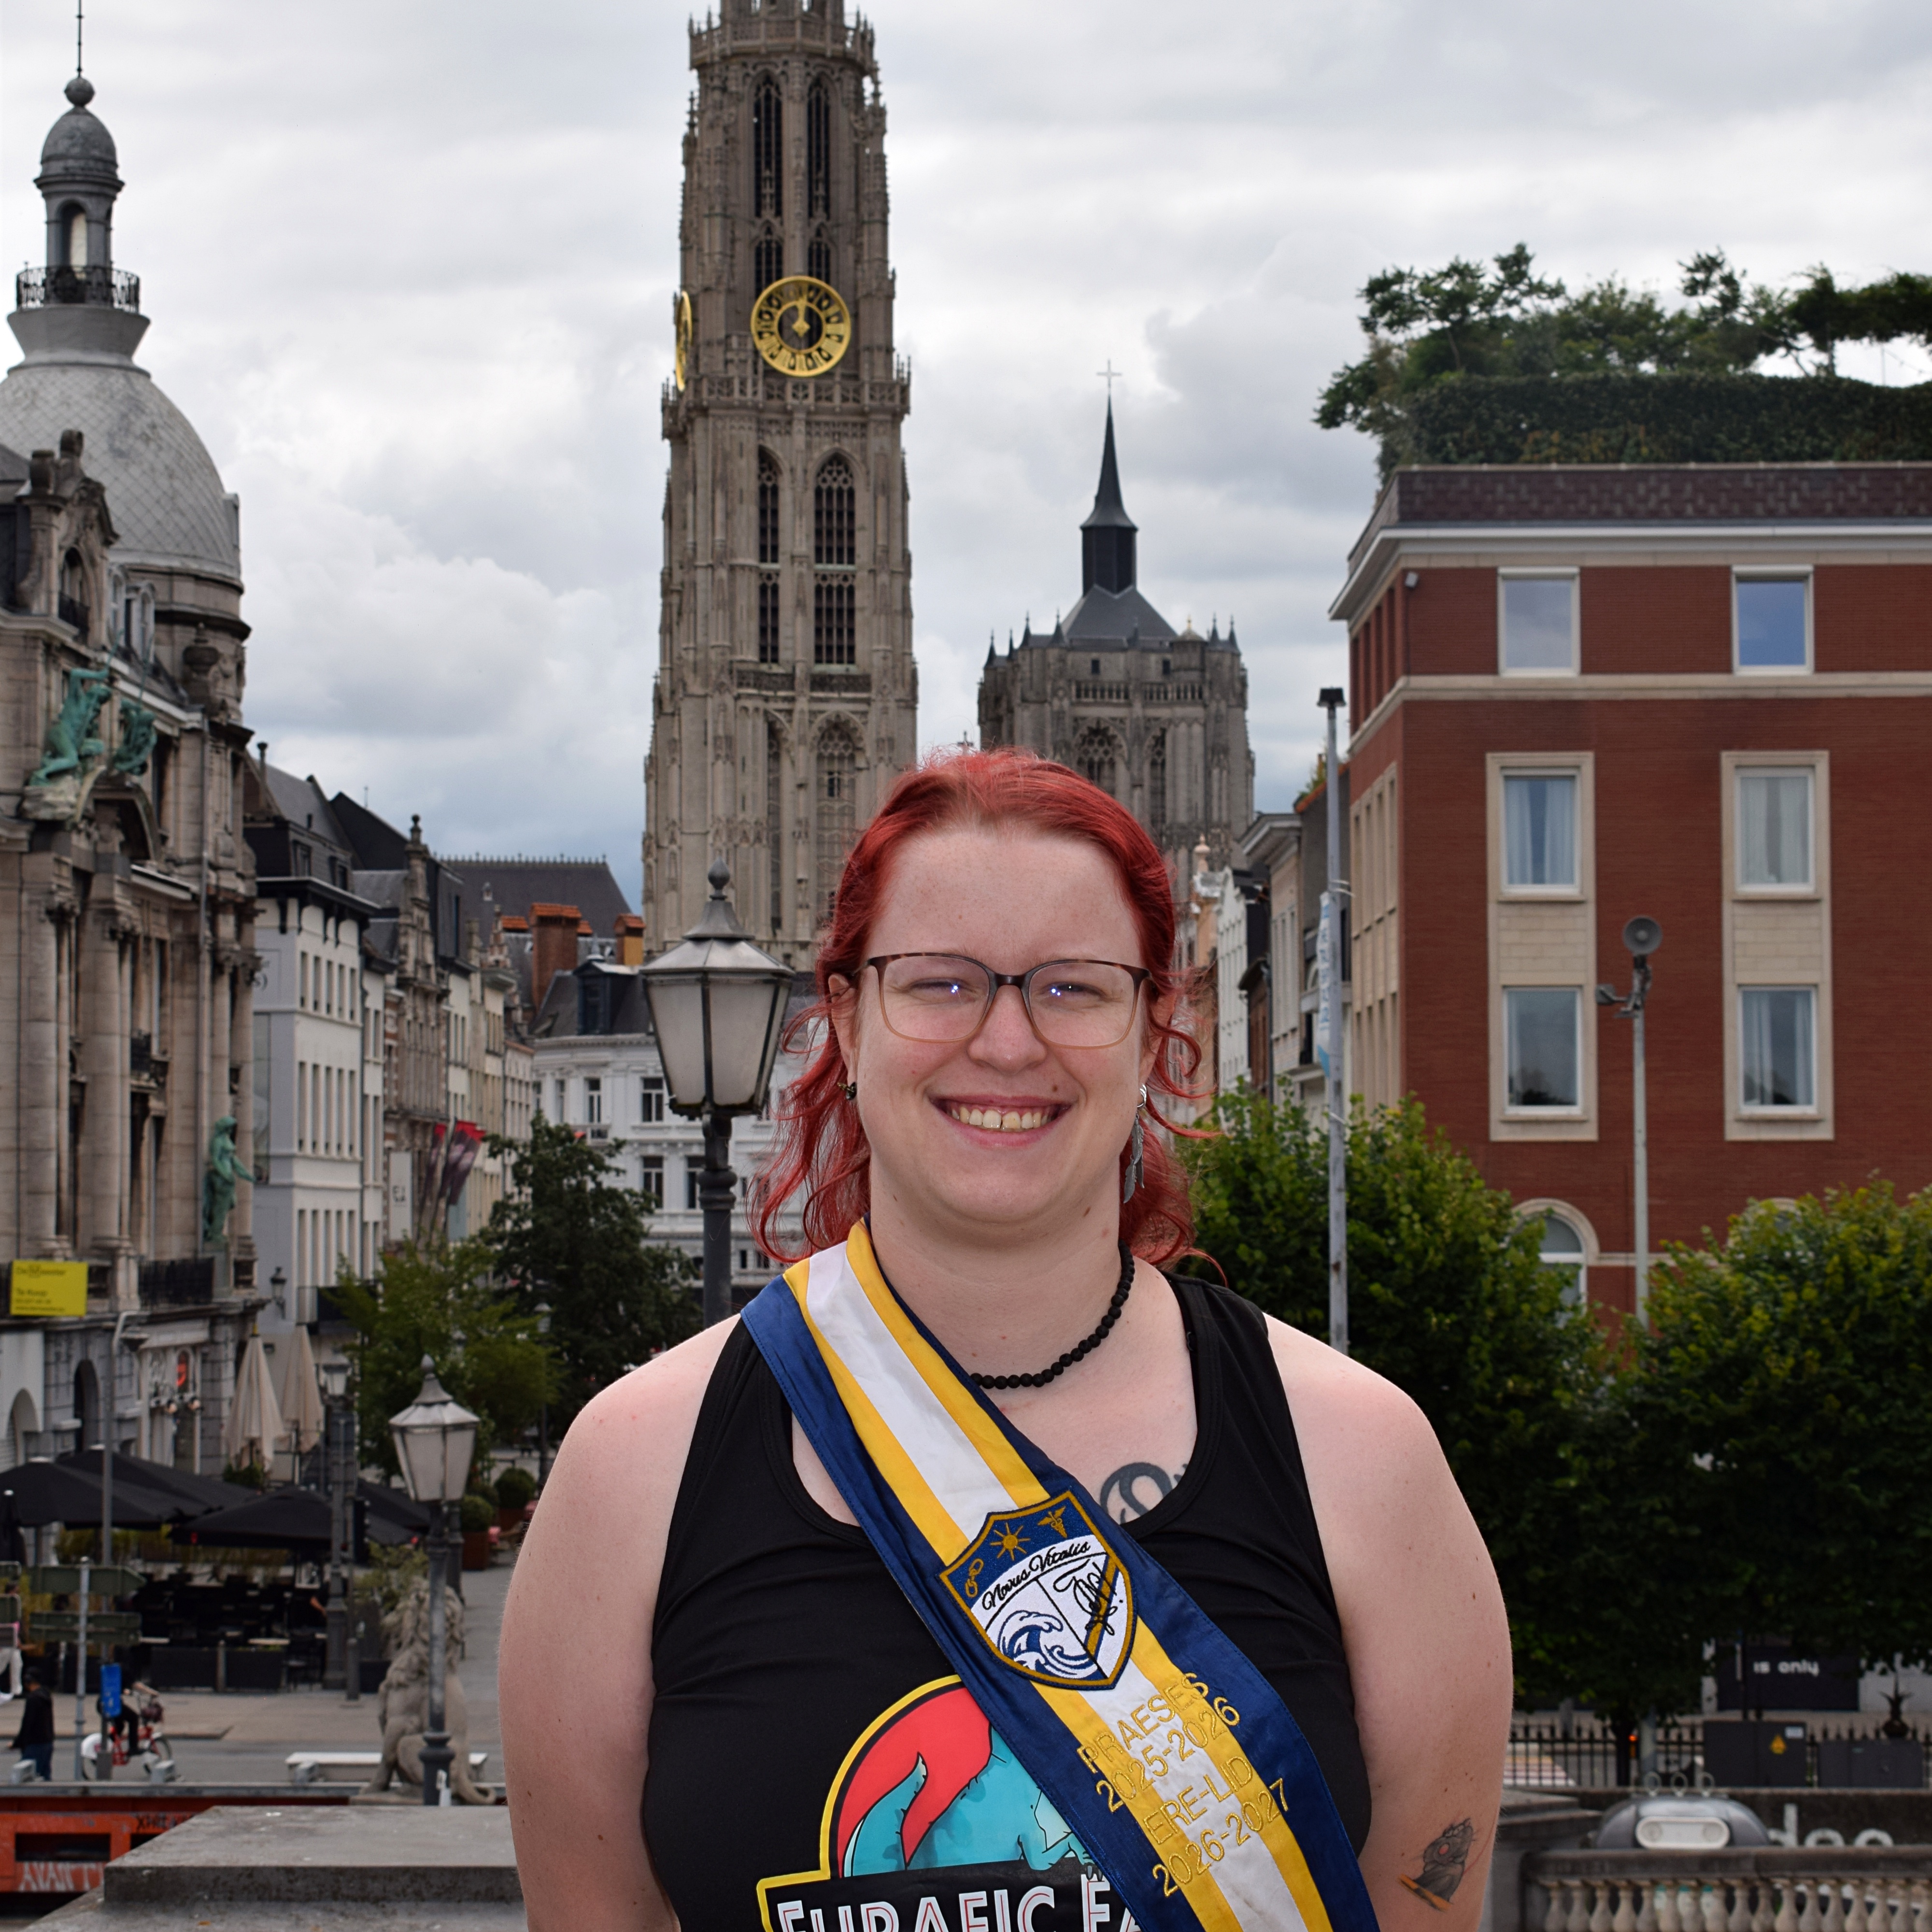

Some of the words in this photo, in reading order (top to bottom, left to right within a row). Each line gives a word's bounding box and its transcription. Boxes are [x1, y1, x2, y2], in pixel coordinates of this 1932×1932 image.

[982, 1568, 1031, 1610] Novus
[1029, 1541, 1091, 1572] Vitalis
[1753, 1661, 1771, 1674] is
[1778, 1659, 1819, 1677] only
[1076, 1672, 1209, 1774] PRAESES
[1096, 1696, 1240, 1813] 2025-2026
[1143, 1756, 1253, 1845] ERE-LID
[1152, 1778, 1289, 1897] 2026-2027
